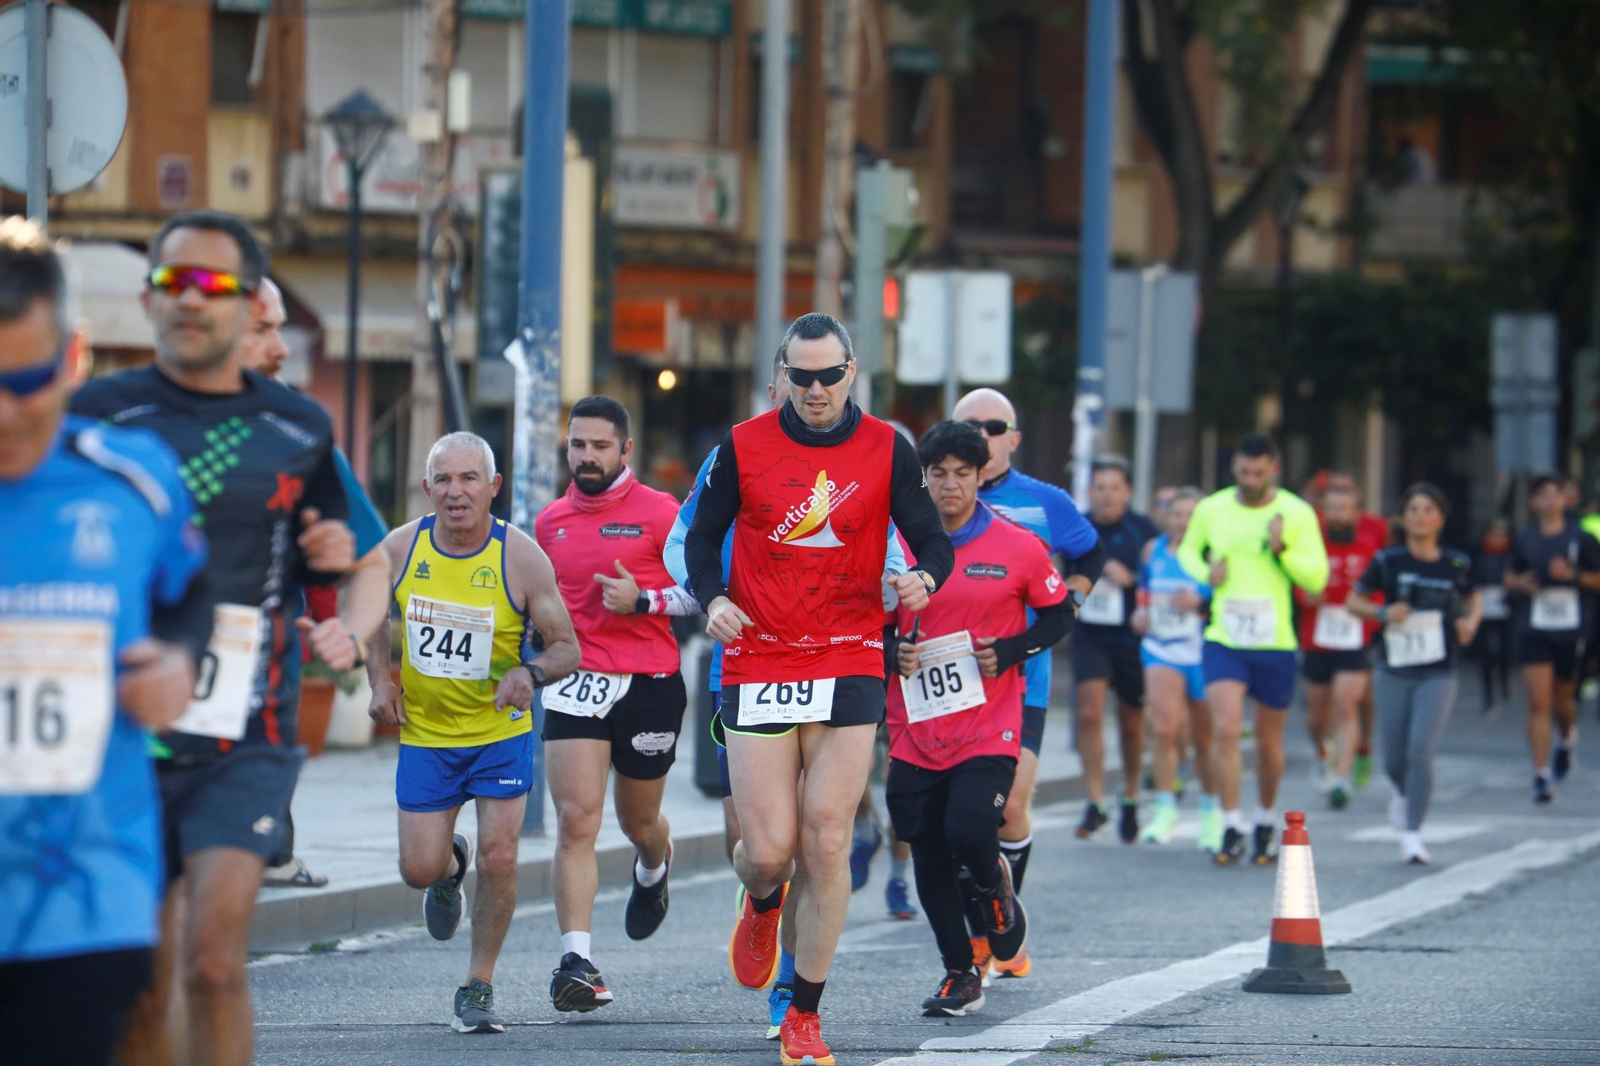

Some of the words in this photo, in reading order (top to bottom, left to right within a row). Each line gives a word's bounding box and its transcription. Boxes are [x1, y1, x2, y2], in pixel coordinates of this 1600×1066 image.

[767, 480, 836, 543] verticalia
[409, 598, 434, 624] XLI
[419, 626, 472, 662] 244
[558, 671, 610, 705] 263
[756, 680, 814, 706] 269
[917, 662, 963, 701] 195
